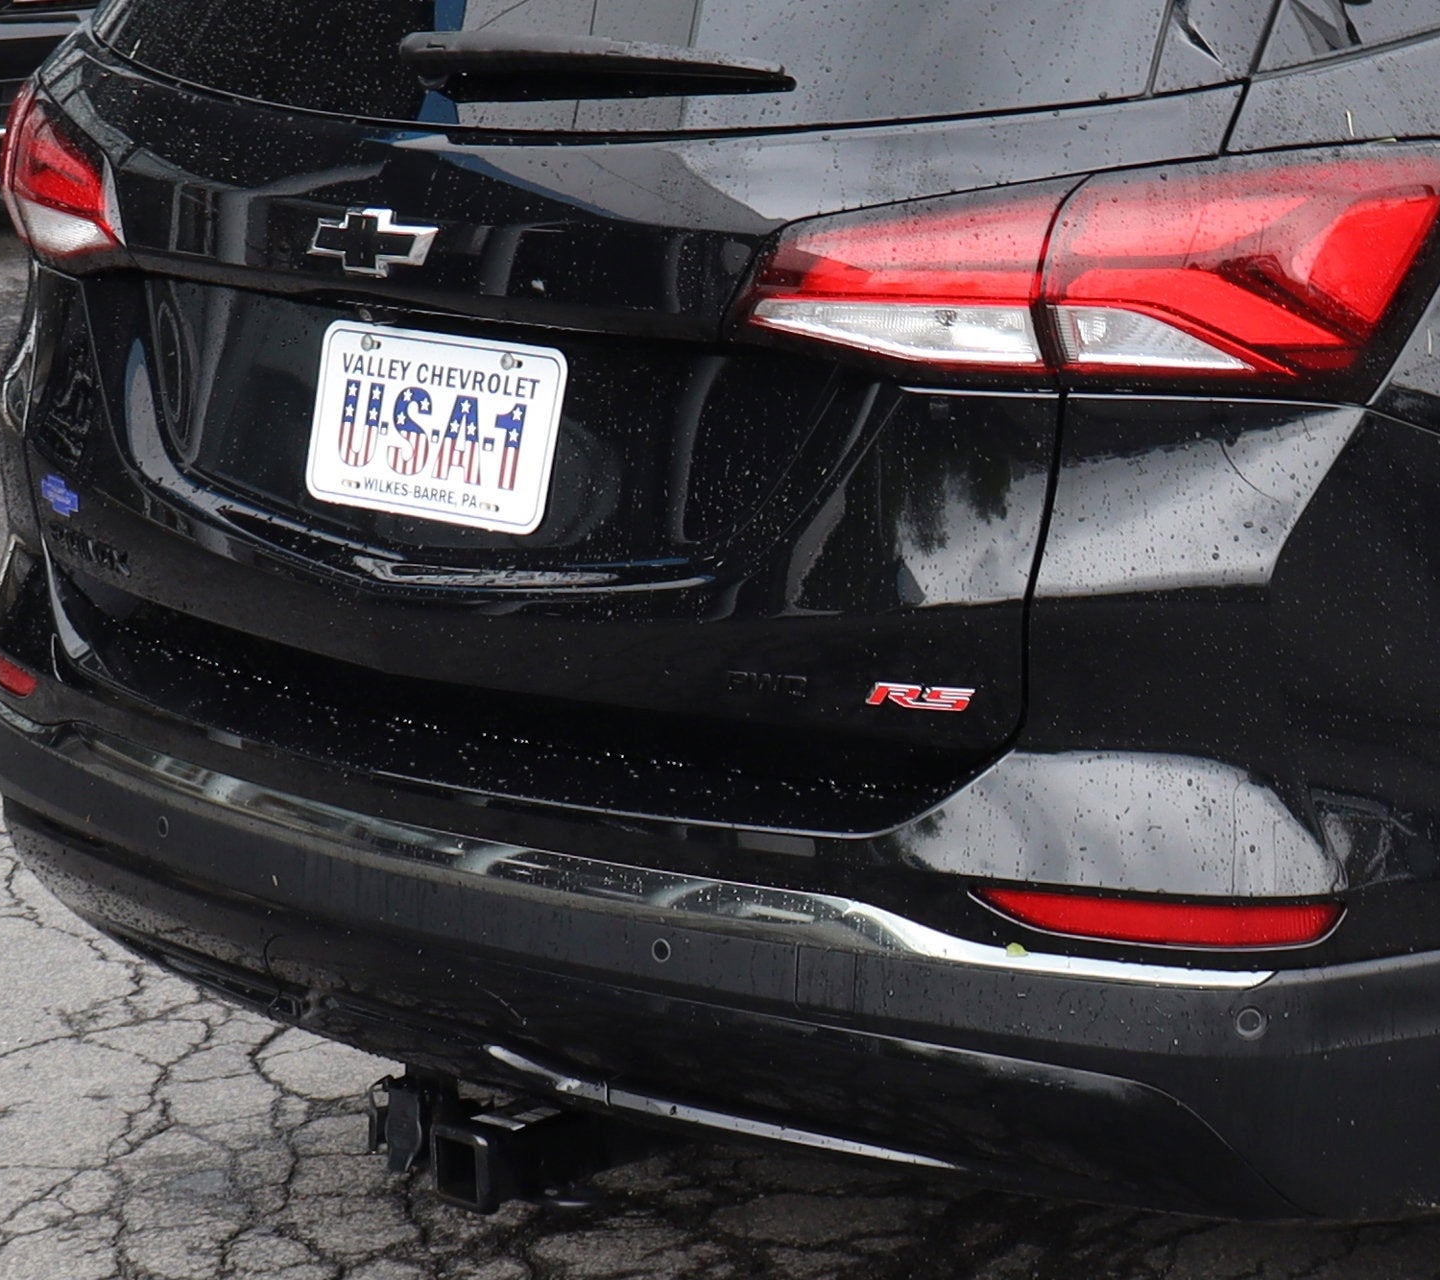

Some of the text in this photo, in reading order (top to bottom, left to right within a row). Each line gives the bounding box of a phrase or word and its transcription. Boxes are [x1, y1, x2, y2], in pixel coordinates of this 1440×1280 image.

[342, 352, 541, 400] VALLEY CHEVROLET
[363, 476, 478, 509] WILKES-BARRE, PA
[865, 681, 976, 712] RS
